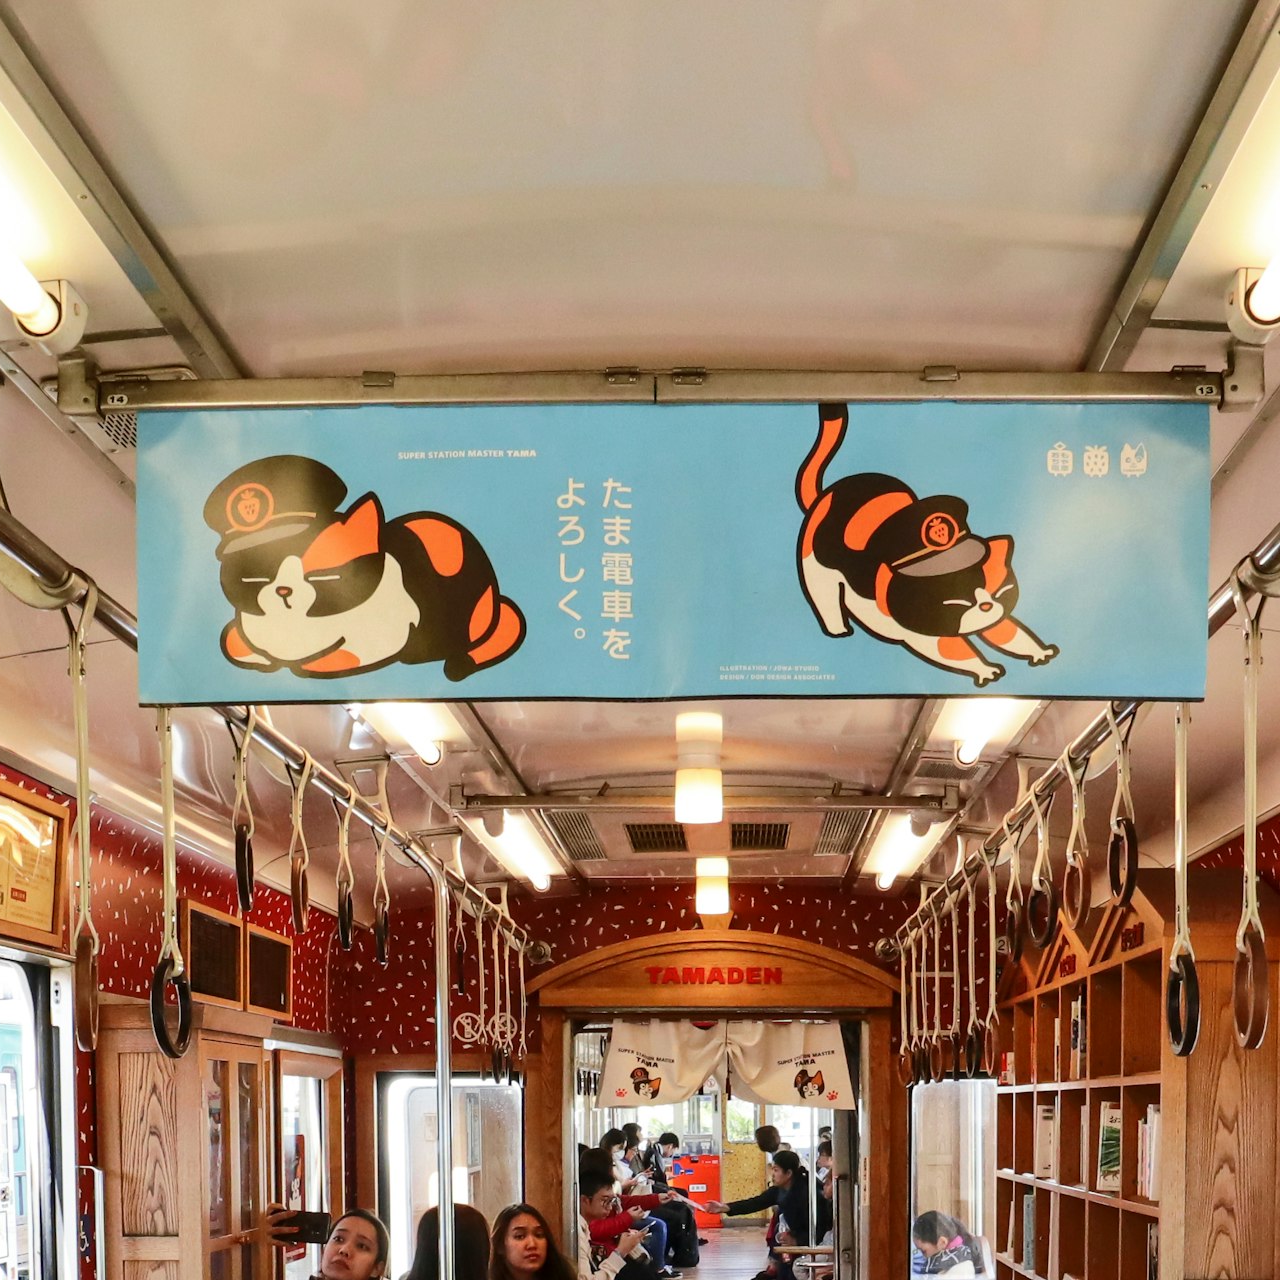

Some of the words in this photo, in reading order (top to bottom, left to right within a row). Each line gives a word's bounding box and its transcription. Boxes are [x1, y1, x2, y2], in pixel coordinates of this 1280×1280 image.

[1198, 386, 1214, 395] 13
[109, 395, 125, 404] 14
[397, 451, 426, 460] SUPER
[427, 450, 465, 460] STATION
[467, 449, 505, 459] MASTER
[507, 449, 537, 458] TAMA
[556, 477, 587, 640] よろしく。
[600, 477, 634, 660] たま電車を
[645, 966, 784, 985] TAMADEN
[617, 1047, 635, 1056] SUPER
[636, 1057, 658, 1069] TAMA
[777, 1058, 793, 1066] SUPER
[811, 1049, 835, 1059] MASTER
[794, 1058, 816, 1068] TAMA
